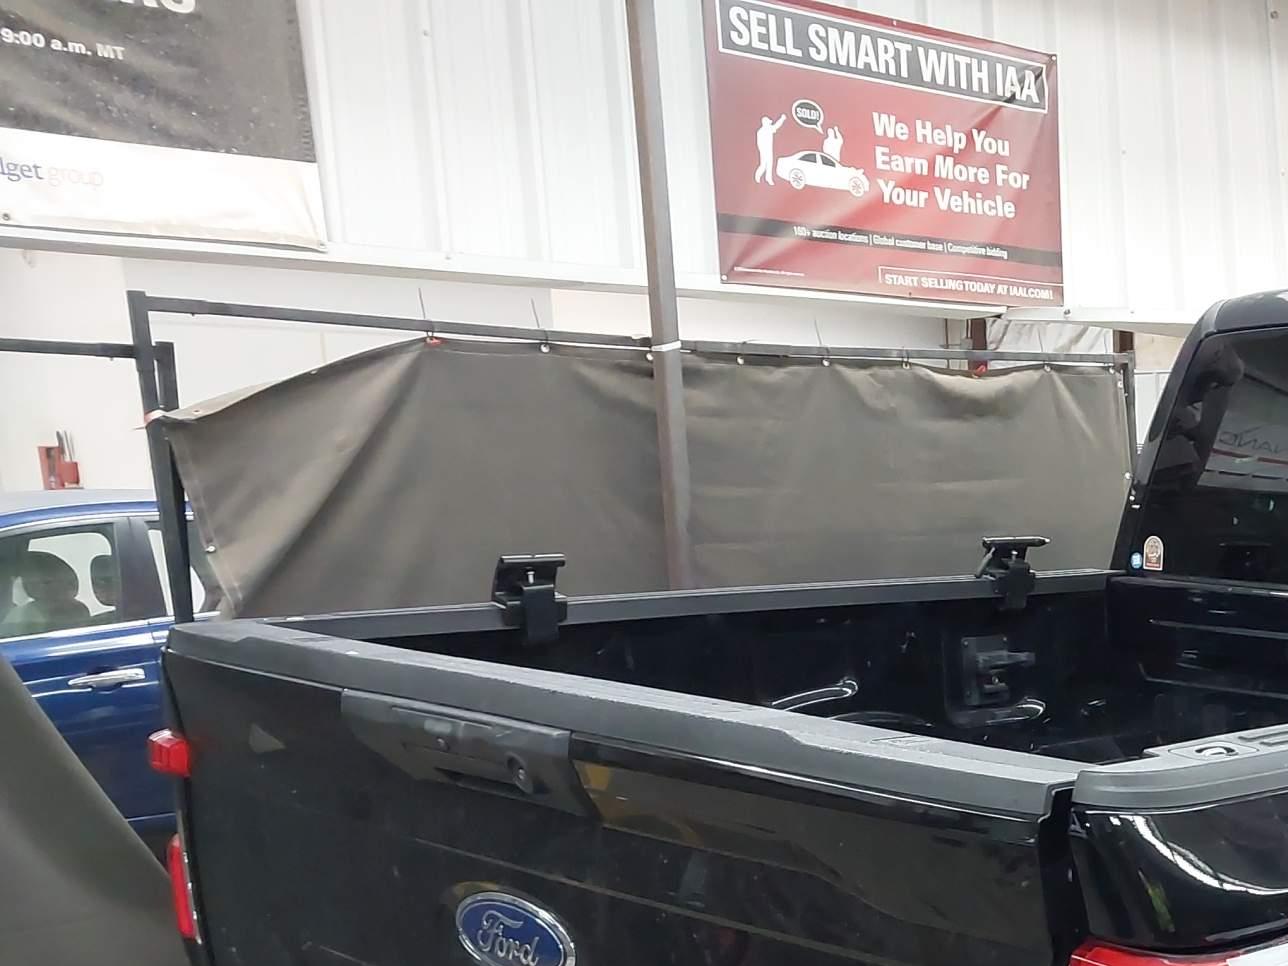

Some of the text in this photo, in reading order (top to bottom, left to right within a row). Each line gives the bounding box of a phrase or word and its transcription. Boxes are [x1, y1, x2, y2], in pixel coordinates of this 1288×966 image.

[0, 27, 125, 60] 9:00 a.m. MT
[728, 6, 1040, 104] SELL SMART WITH IAA
[872, 111, 1010, 157] We Help You
[874, 145, 1031, 190] Earn More For
[876, 178, 1016, 219] Your Vehicle
[884, 274, 919, 287] START
[920, 277, 963, 290] SELLING
[964, 282, 995, 294] TODAY
[997, 284, 1010, 294] AT
[476, 909, 540, 966] Ford
